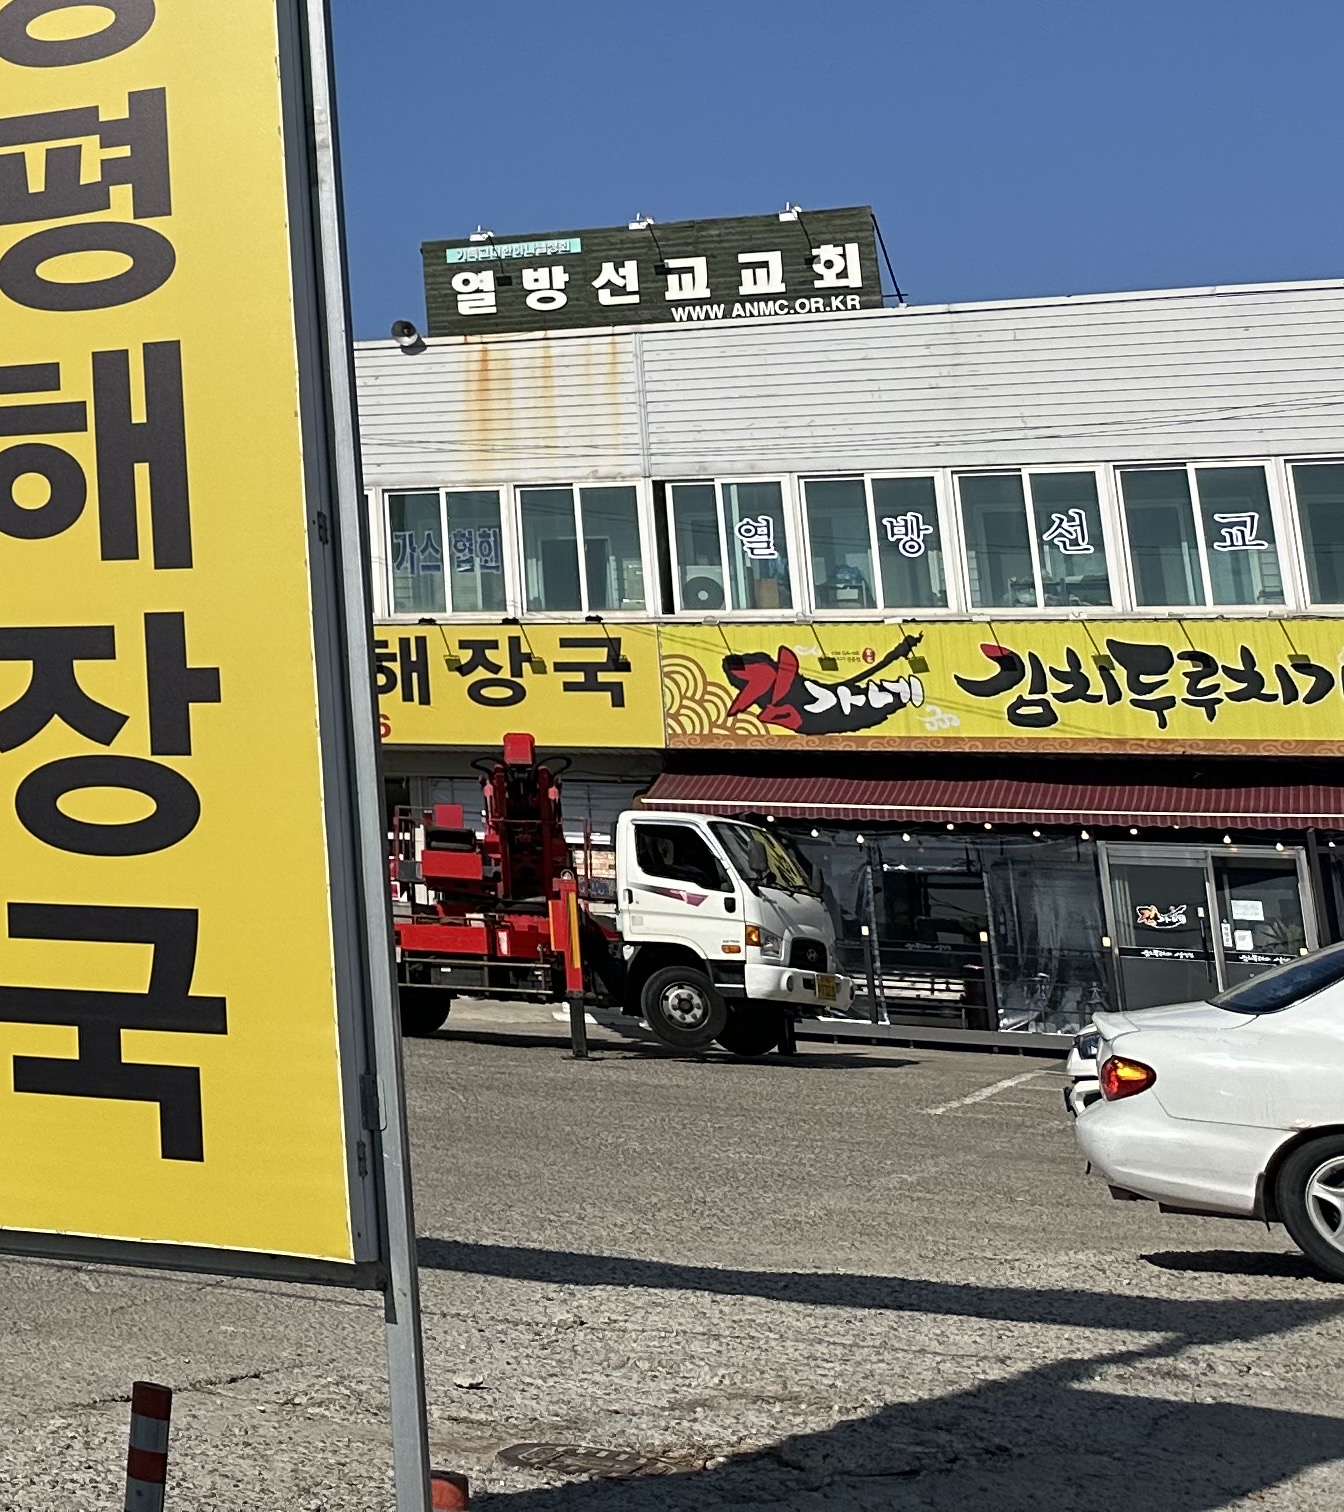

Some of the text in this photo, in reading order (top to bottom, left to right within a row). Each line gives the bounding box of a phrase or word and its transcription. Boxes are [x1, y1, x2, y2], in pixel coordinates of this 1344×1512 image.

[450, 242, 863, 316] 열방선교교회
[393, 530, 442, 576] 가스
[374, 635, 632, 708] 해장국
